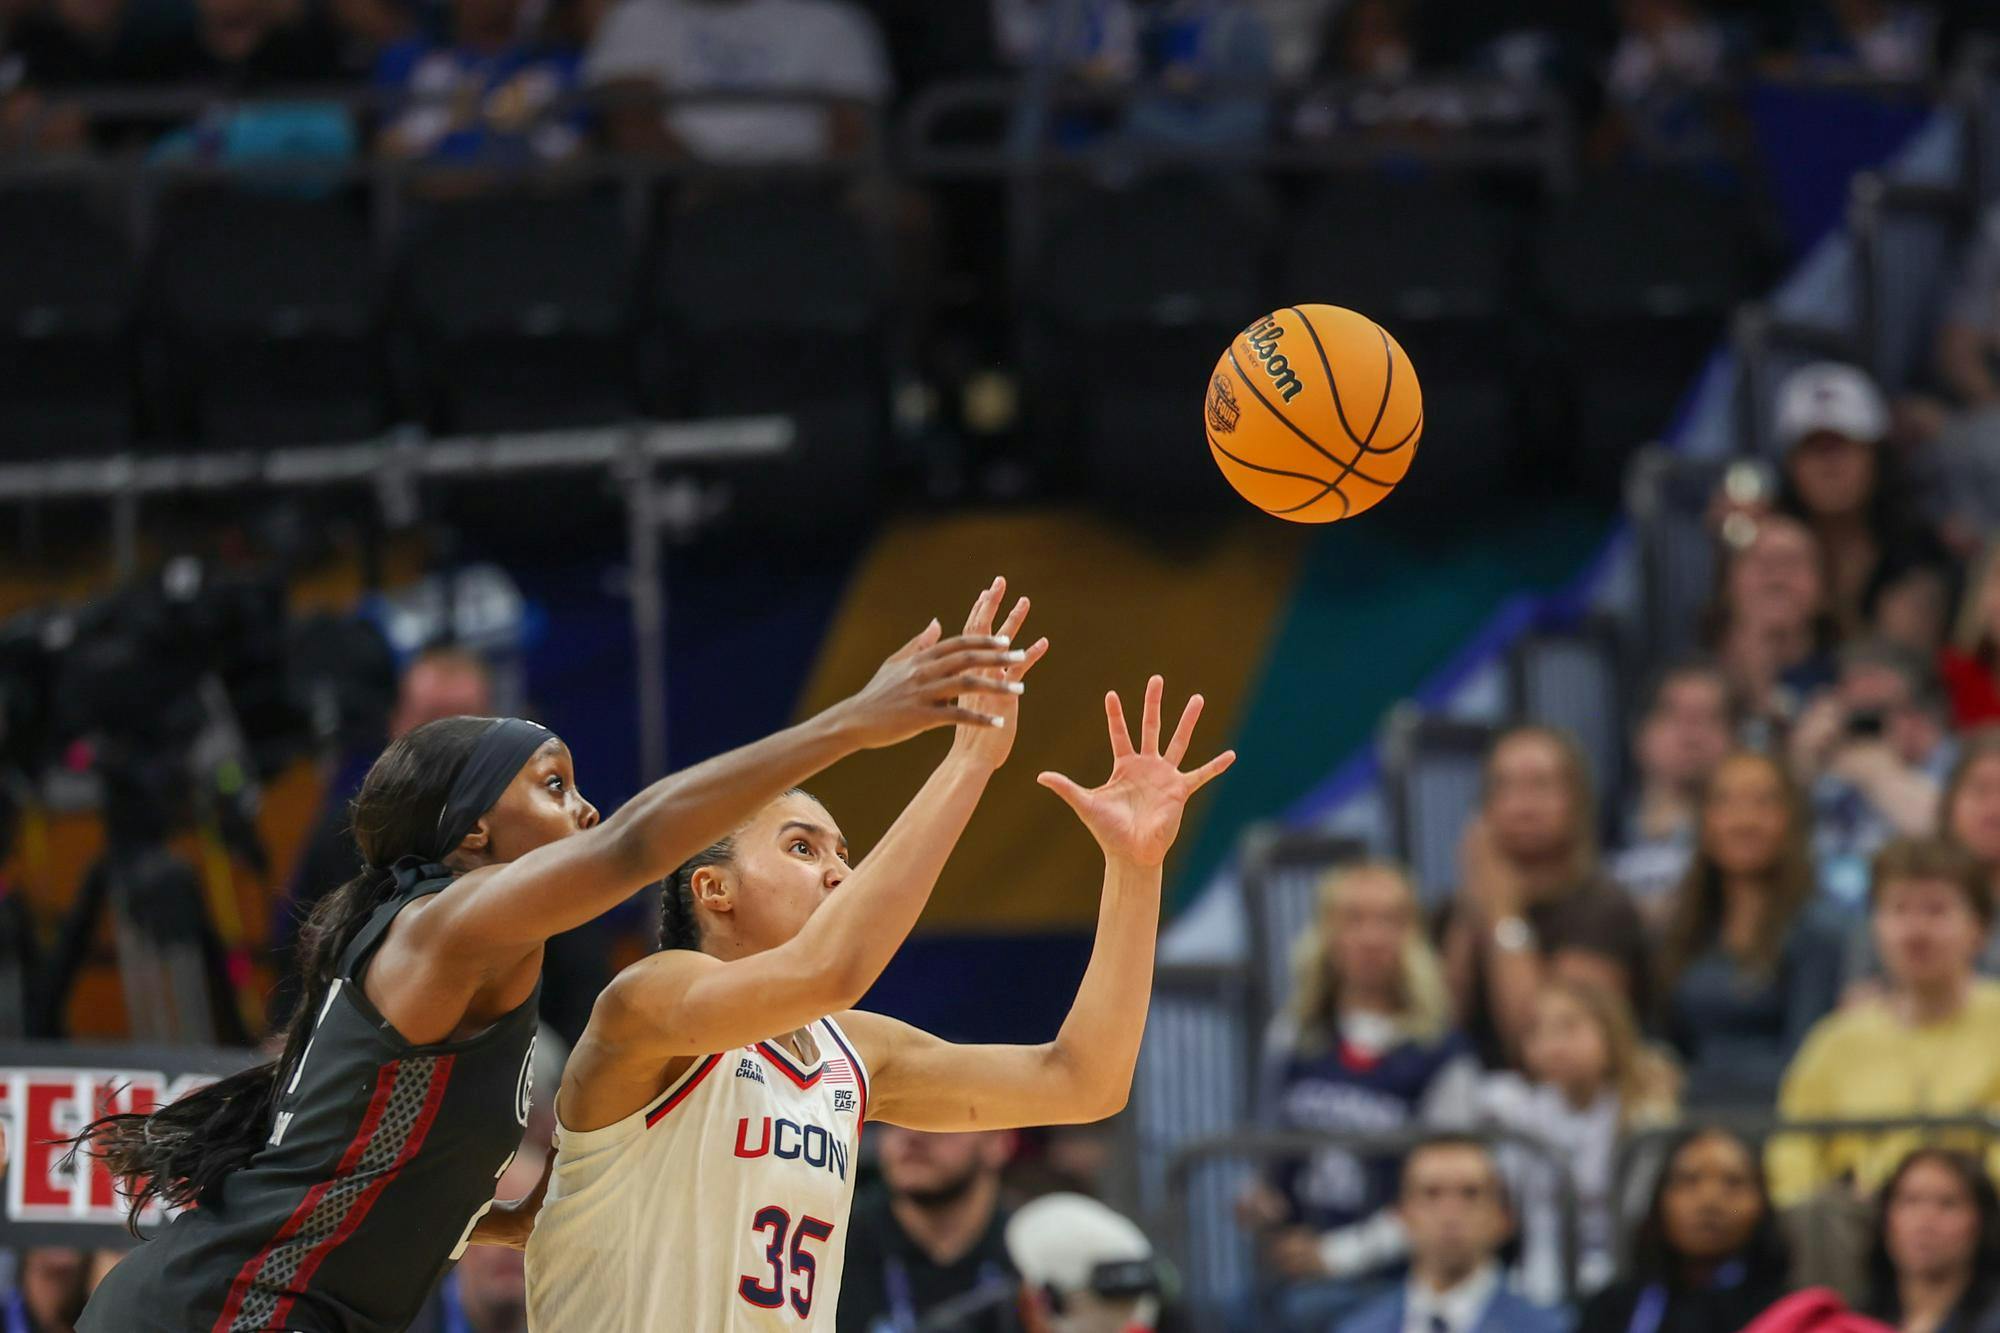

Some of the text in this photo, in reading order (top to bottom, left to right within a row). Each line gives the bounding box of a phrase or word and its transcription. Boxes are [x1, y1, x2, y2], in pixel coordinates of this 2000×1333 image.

[740, 1058, 753, 1070] BE
[834, 1090, 853, 1100] BIG
[834, 1100, 857, 1111] EAST
[734, 1116, 848, 1182] UCON
[738, 1205, 835, 1320] 35
